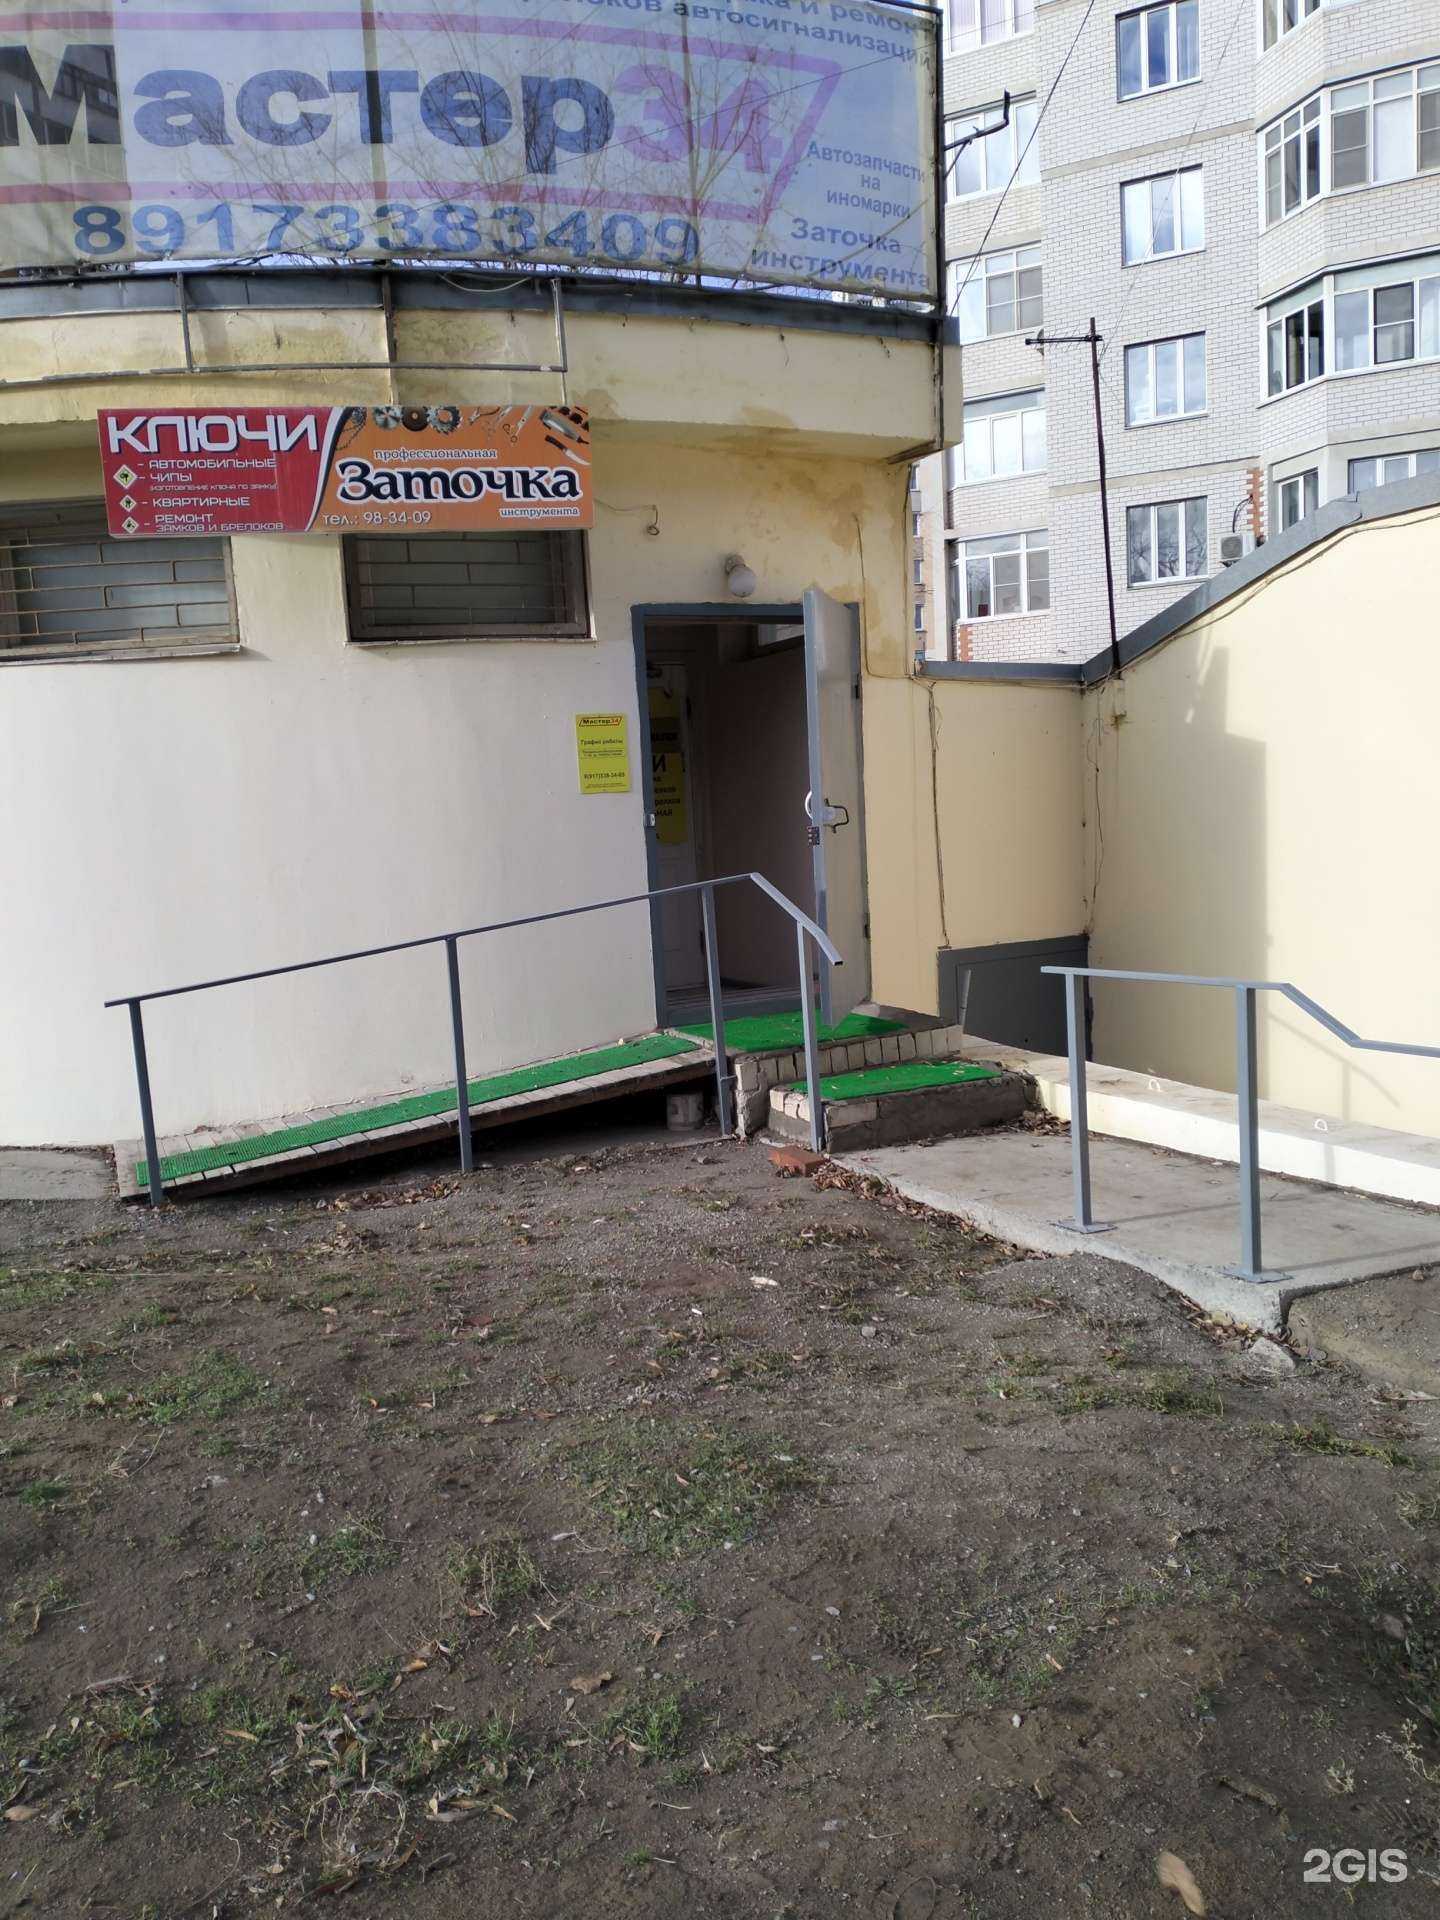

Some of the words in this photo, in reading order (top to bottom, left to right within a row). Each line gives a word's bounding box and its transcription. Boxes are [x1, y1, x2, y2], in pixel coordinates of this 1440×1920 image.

[860, 174, 880, 191] на
[826, 189, 910, 218] иномарки
[73, 203, 700, 265] 89173383409
[791, 218, 902, 253] Заточка
[751, 248, 930, 288] инструмента
[107, 414, 318, 453] КЛЮЧИ
[374, 448, 496, 463] профессиональная
[149, 458, 277, 469] АВТОМОБИЛЬНЫЕ
[151, 472, 192, 481] ЧИПЫ
[338, 459, 581, 502] Заточка
[153, 497, 251, 507] КВАРТИРНЫЕ
[155, 513, 213, 523] РЕМОНТ
[364, 512, 431, 525] 98-34-09
[500, 508, 578, 518] инструмента
[157, 523, 205, 532] ЗАМКОВ
[208, 523, 217, 531] И
